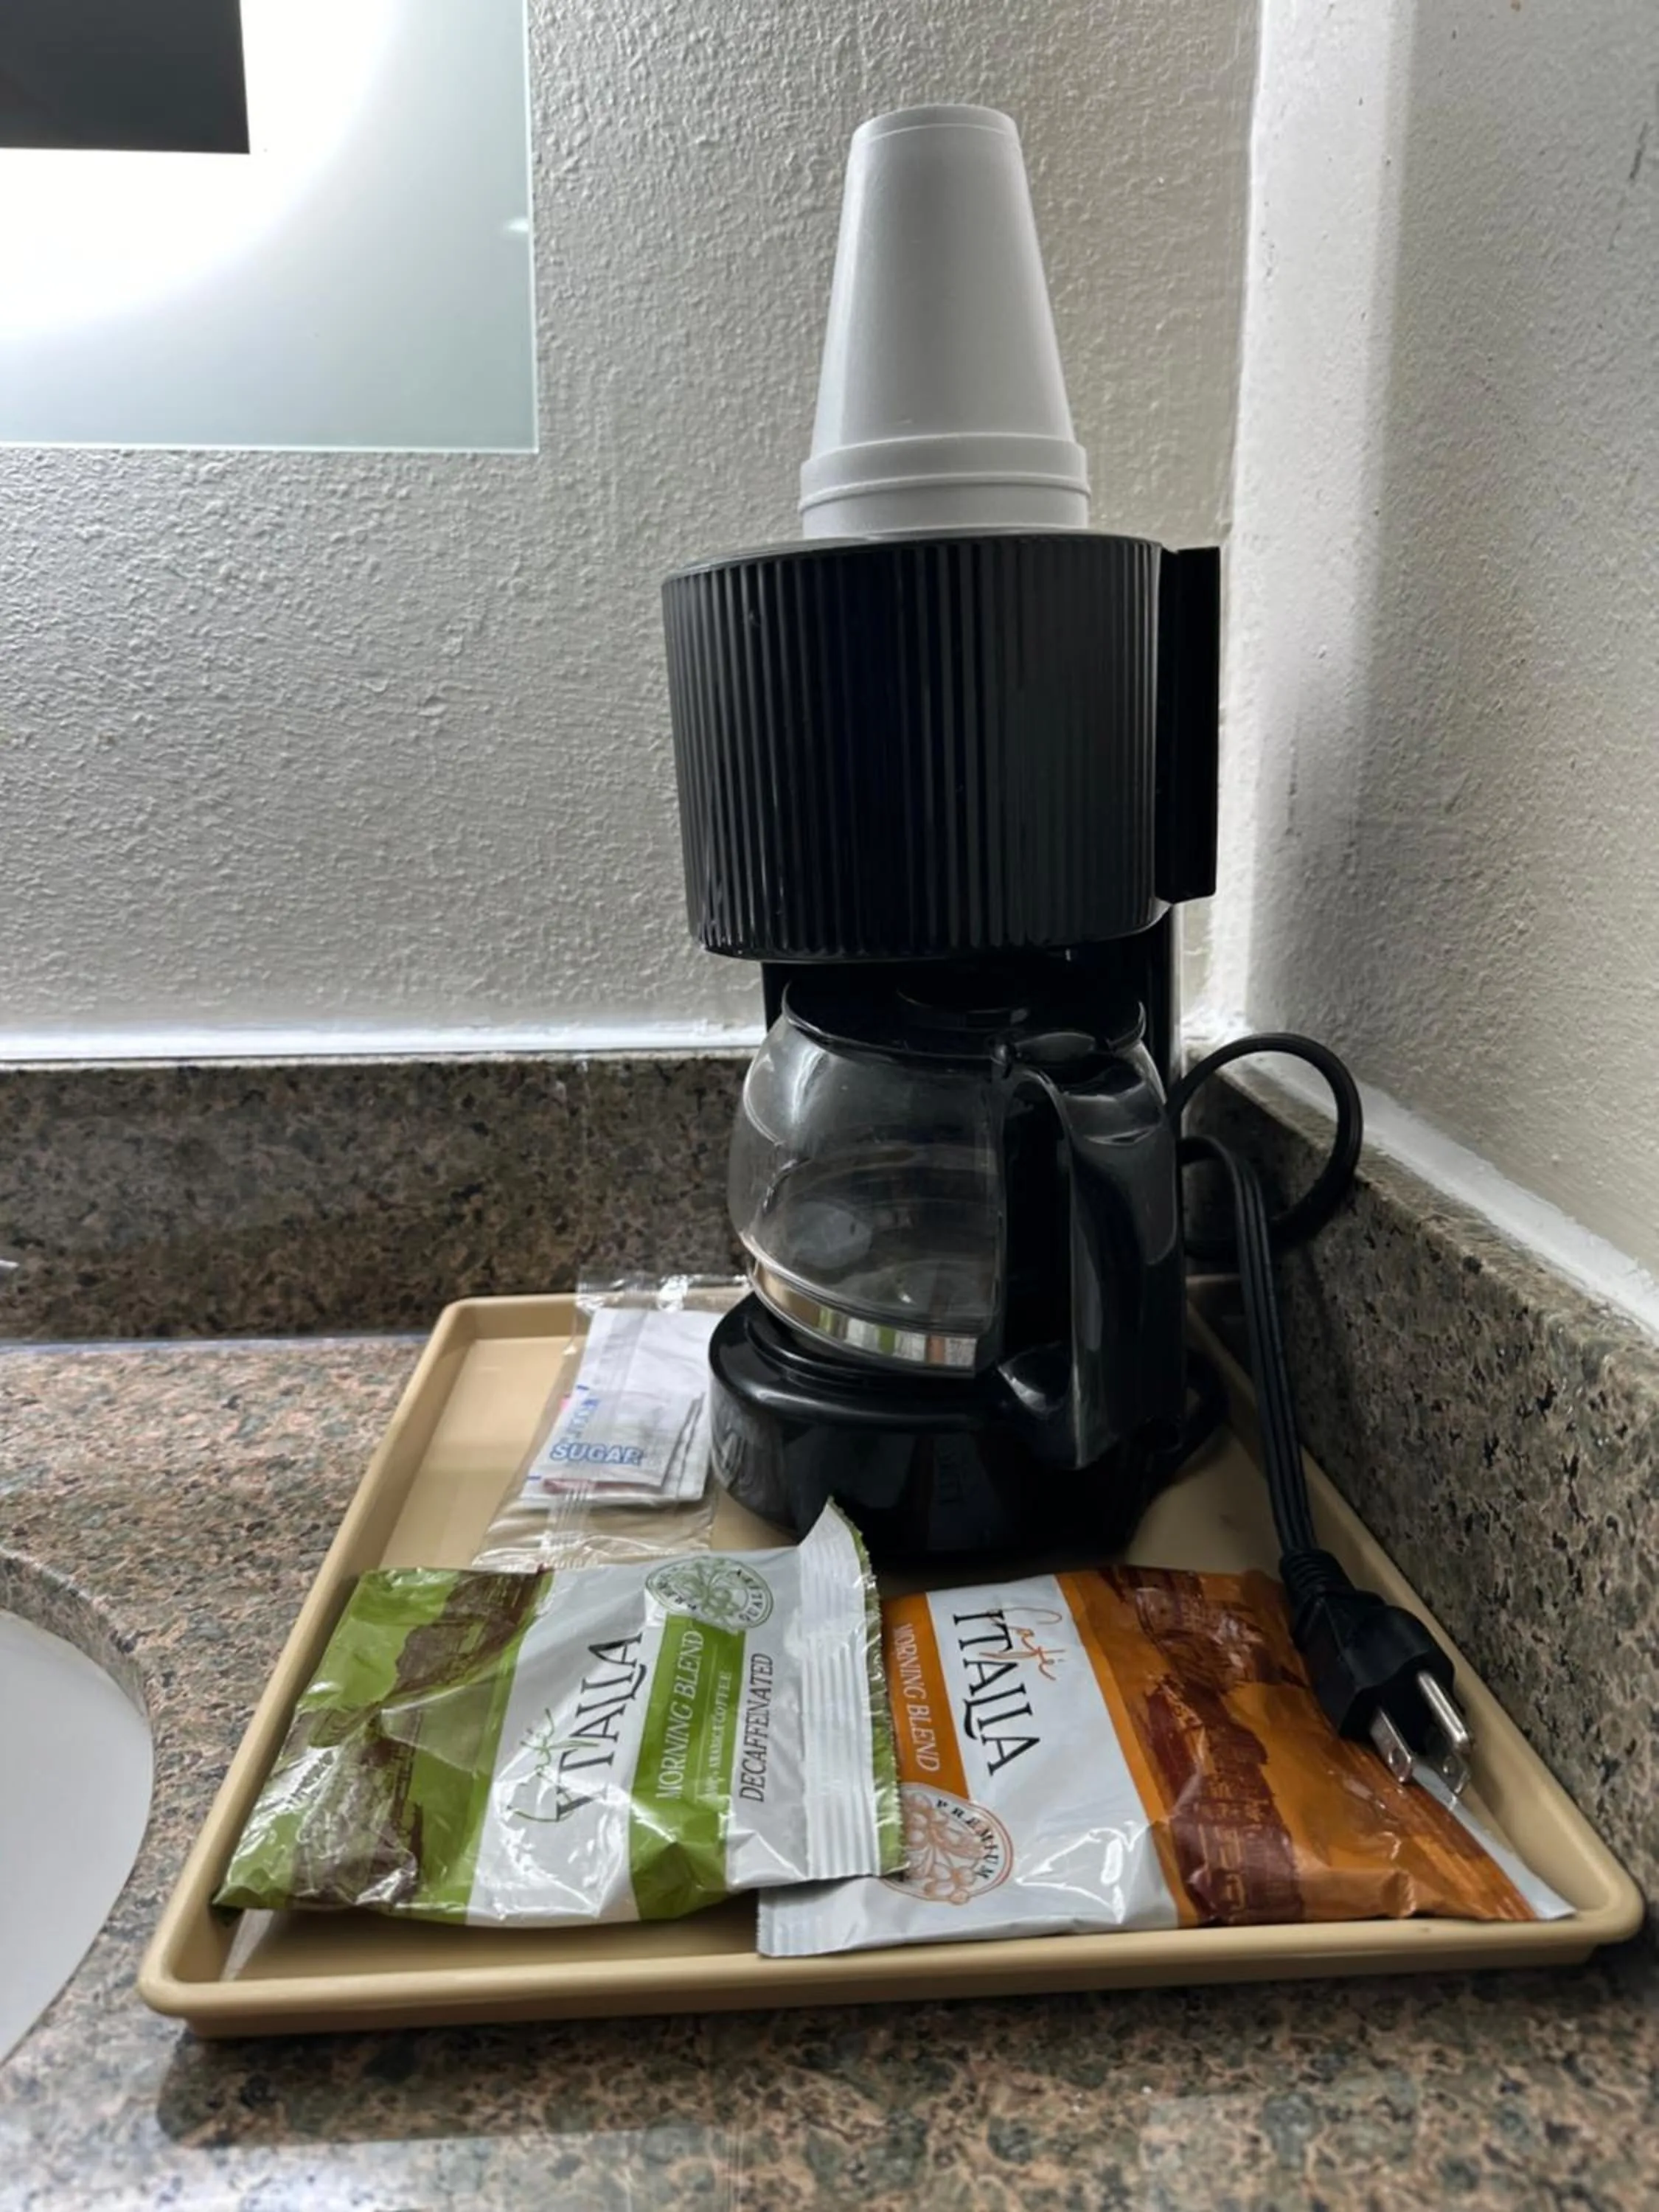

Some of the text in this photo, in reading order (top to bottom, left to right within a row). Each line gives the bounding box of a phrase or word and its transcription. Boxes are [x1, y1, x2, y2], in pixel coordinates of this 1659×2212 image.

[550, 1442, 644, 1465] SUGAR
[556, 1632, 647, 1821] ITALIA
[655, 1630, 705, 1799] MORNING BLEND
[740, 1653, 773, 1803] DECAFFEINATED
[893, 1624, 941, 1772] MORNING BLEND
[953, 1609, 1041, 1776] ITALIA
[936, 1799, 1000, 1880] PREMIUM
